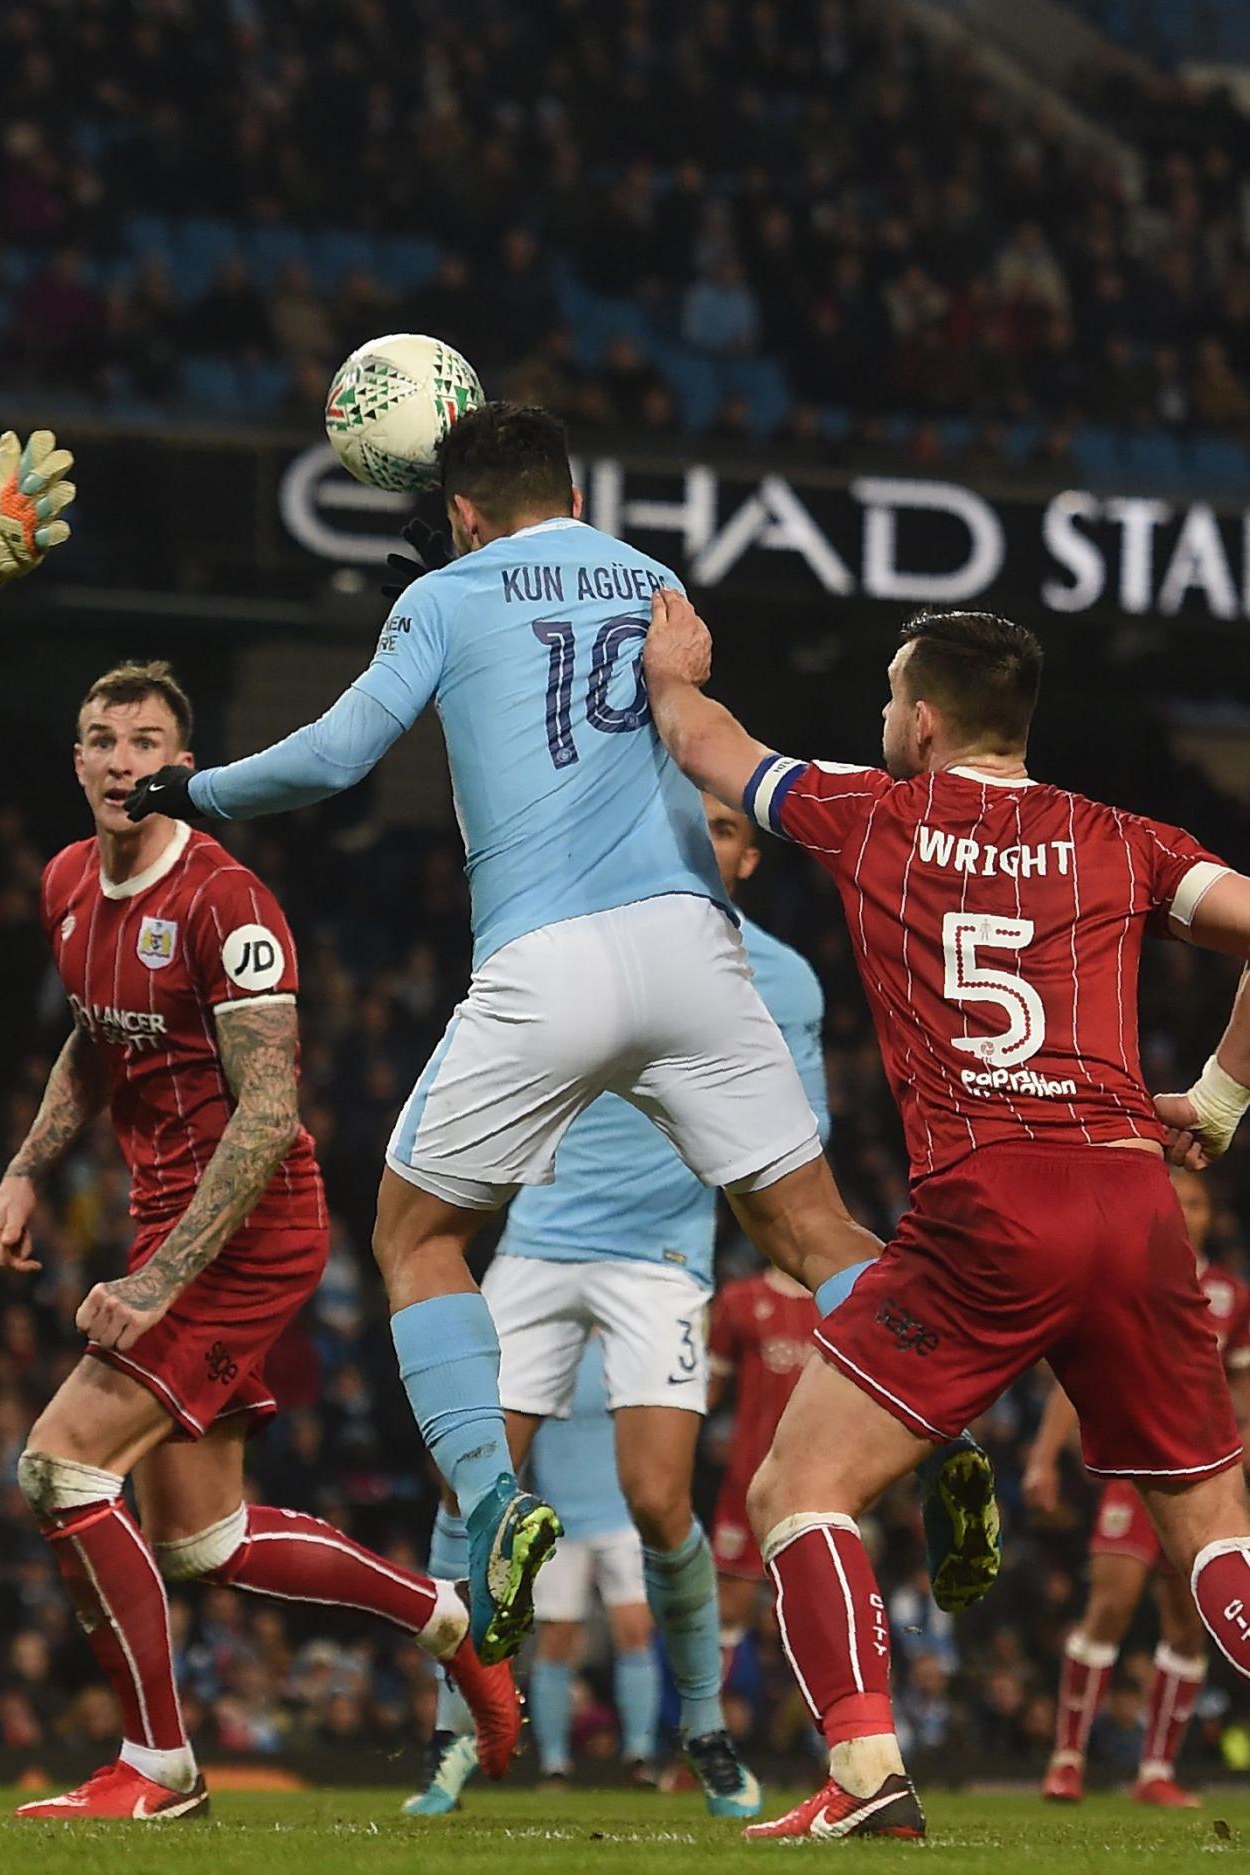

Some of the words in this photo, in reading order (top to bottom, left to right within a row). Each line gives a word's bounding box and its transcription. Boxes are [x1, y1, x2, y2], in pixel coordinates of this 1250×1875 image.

[280, 444, 1006, 604] EHAD
[1042, 488, 1250, 621] STA
[502, 566, 565, 603] KUN
[532, 617, 651, 770] 10
[918, 826, 1073, 877] WRIGHT
[234, 940, 275, 977] JD
[942, 911, 1045, 1067] 5
[93, 1004, 168, 1034] LANCER
[676, 1318, 698, 1373] 3
[869, 1592, 888, 1655] CITY
